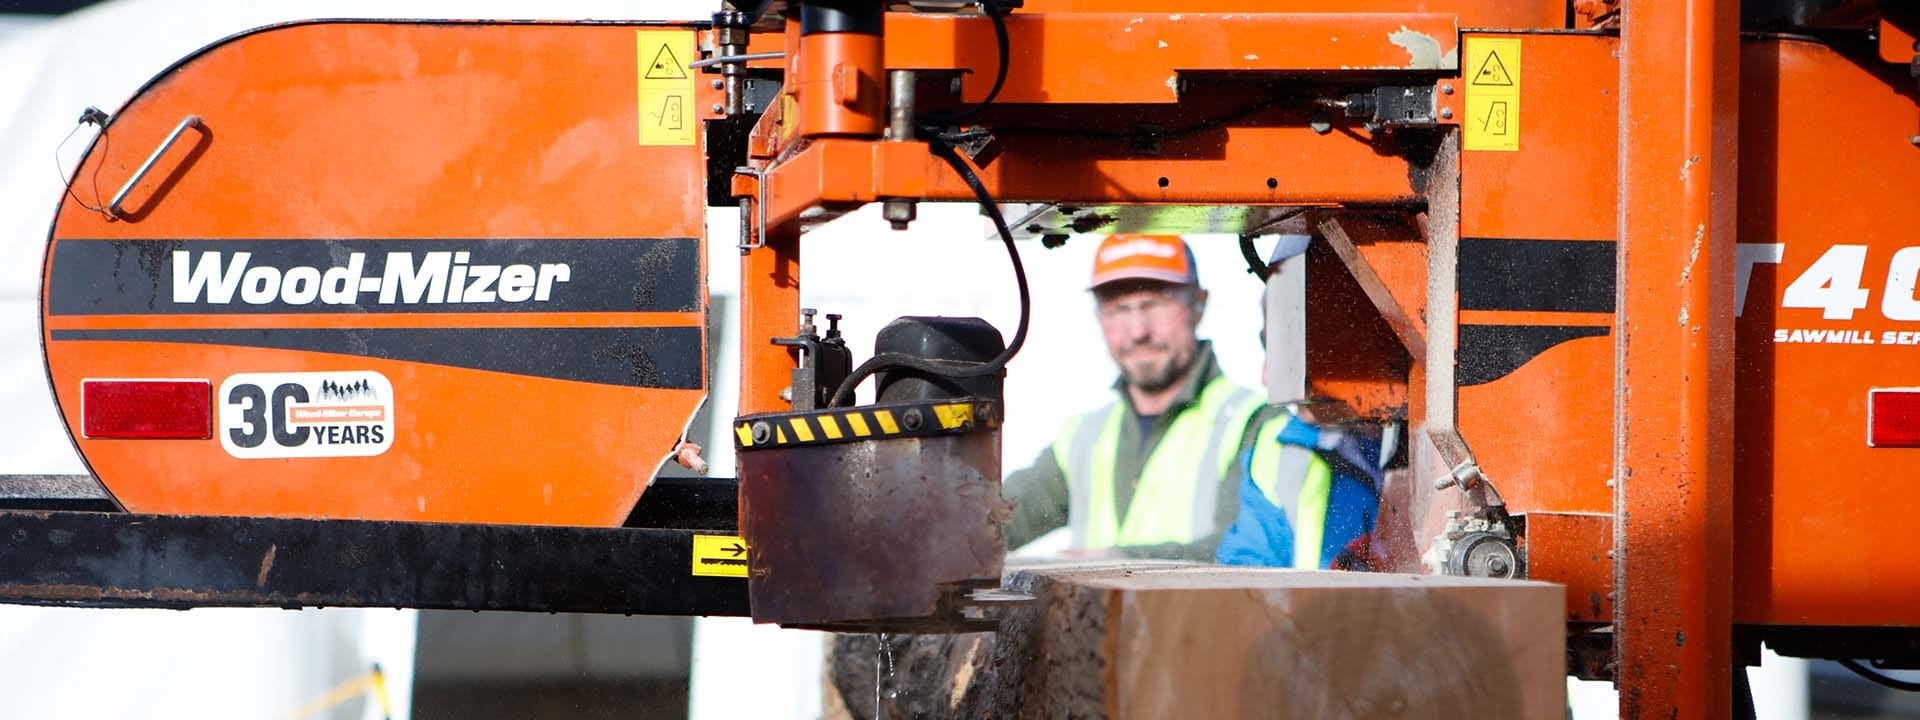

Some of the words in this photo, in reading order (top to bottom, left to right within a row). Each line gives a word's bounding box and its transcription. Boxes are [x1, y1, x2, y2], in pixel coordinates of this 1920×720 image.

[172, 251, 570, 304] Wood-Mizer
[1773, 329, 1875, 345] SAWMILL
[313, 424, 384, 444] YEARS
